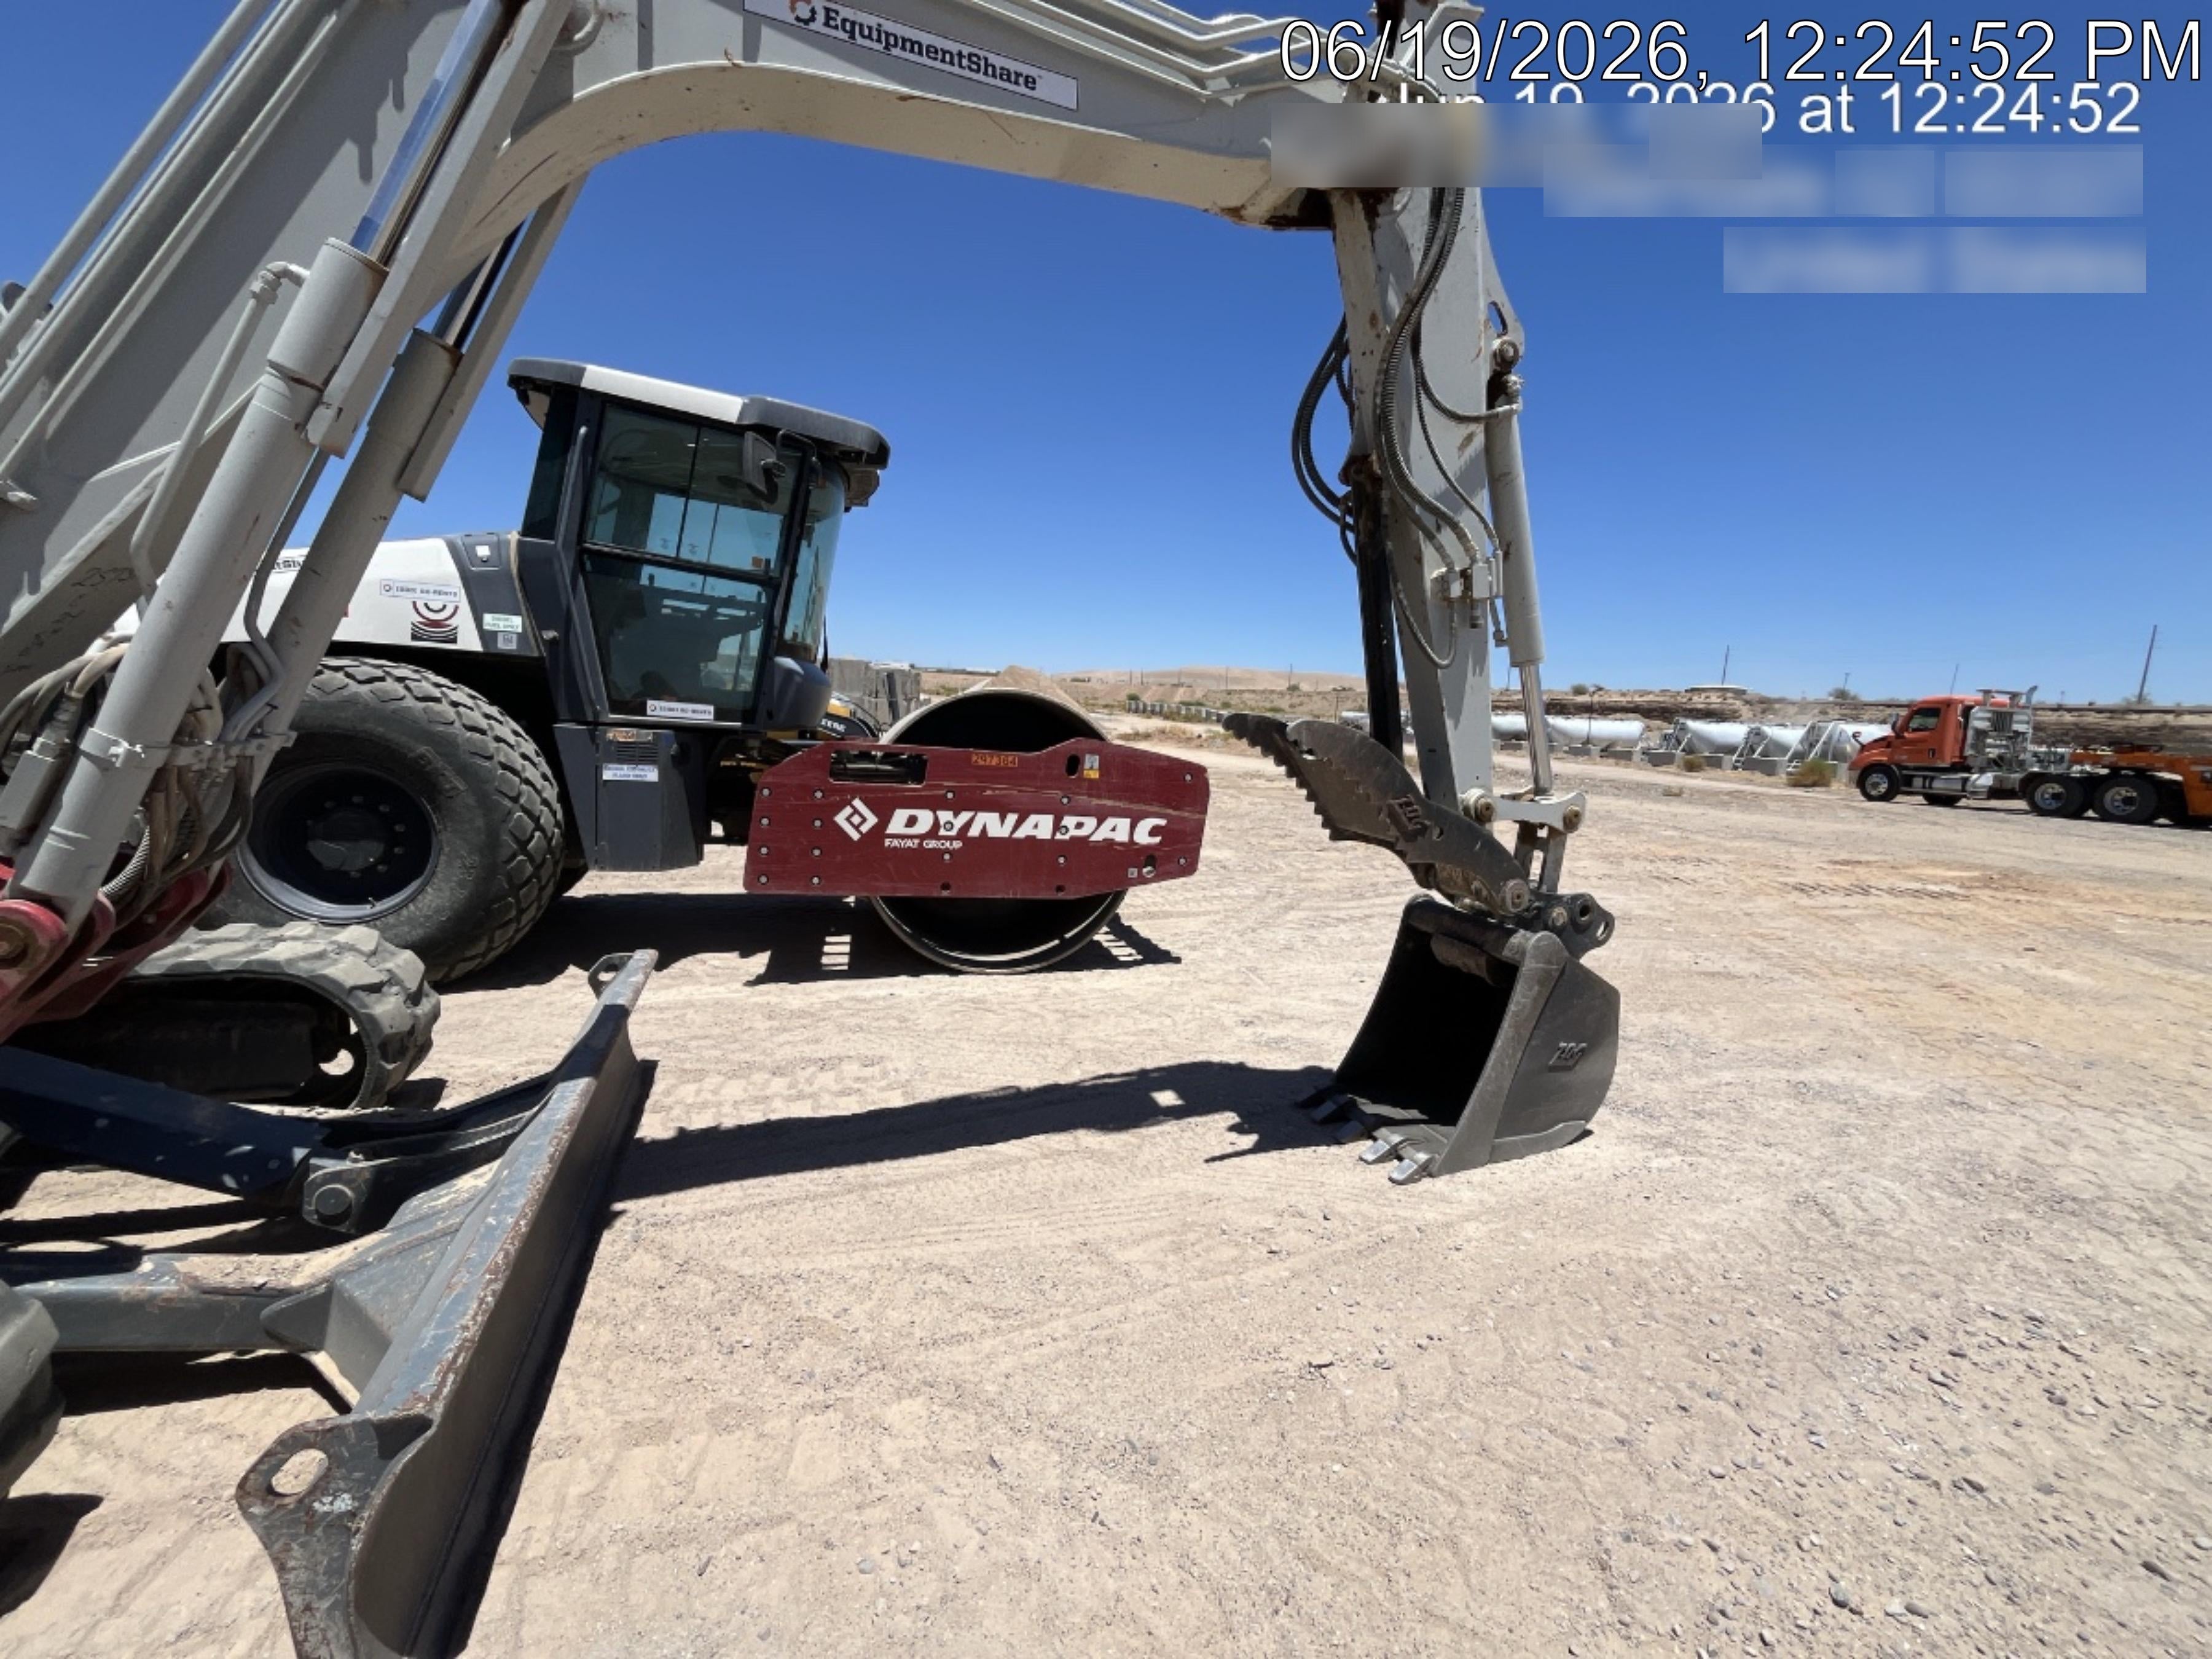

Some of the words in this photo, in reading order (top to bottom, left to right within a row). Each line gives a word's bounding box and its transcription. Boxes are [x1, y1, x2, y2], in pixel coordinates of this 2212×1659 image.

[822, 5, 1037, 92] EquipmentShare
[884, 837, 921, 849] FAYAT
[923, 839, 963, 850] GROUP
[885, 808, 1167, 844] DYNAPAC
